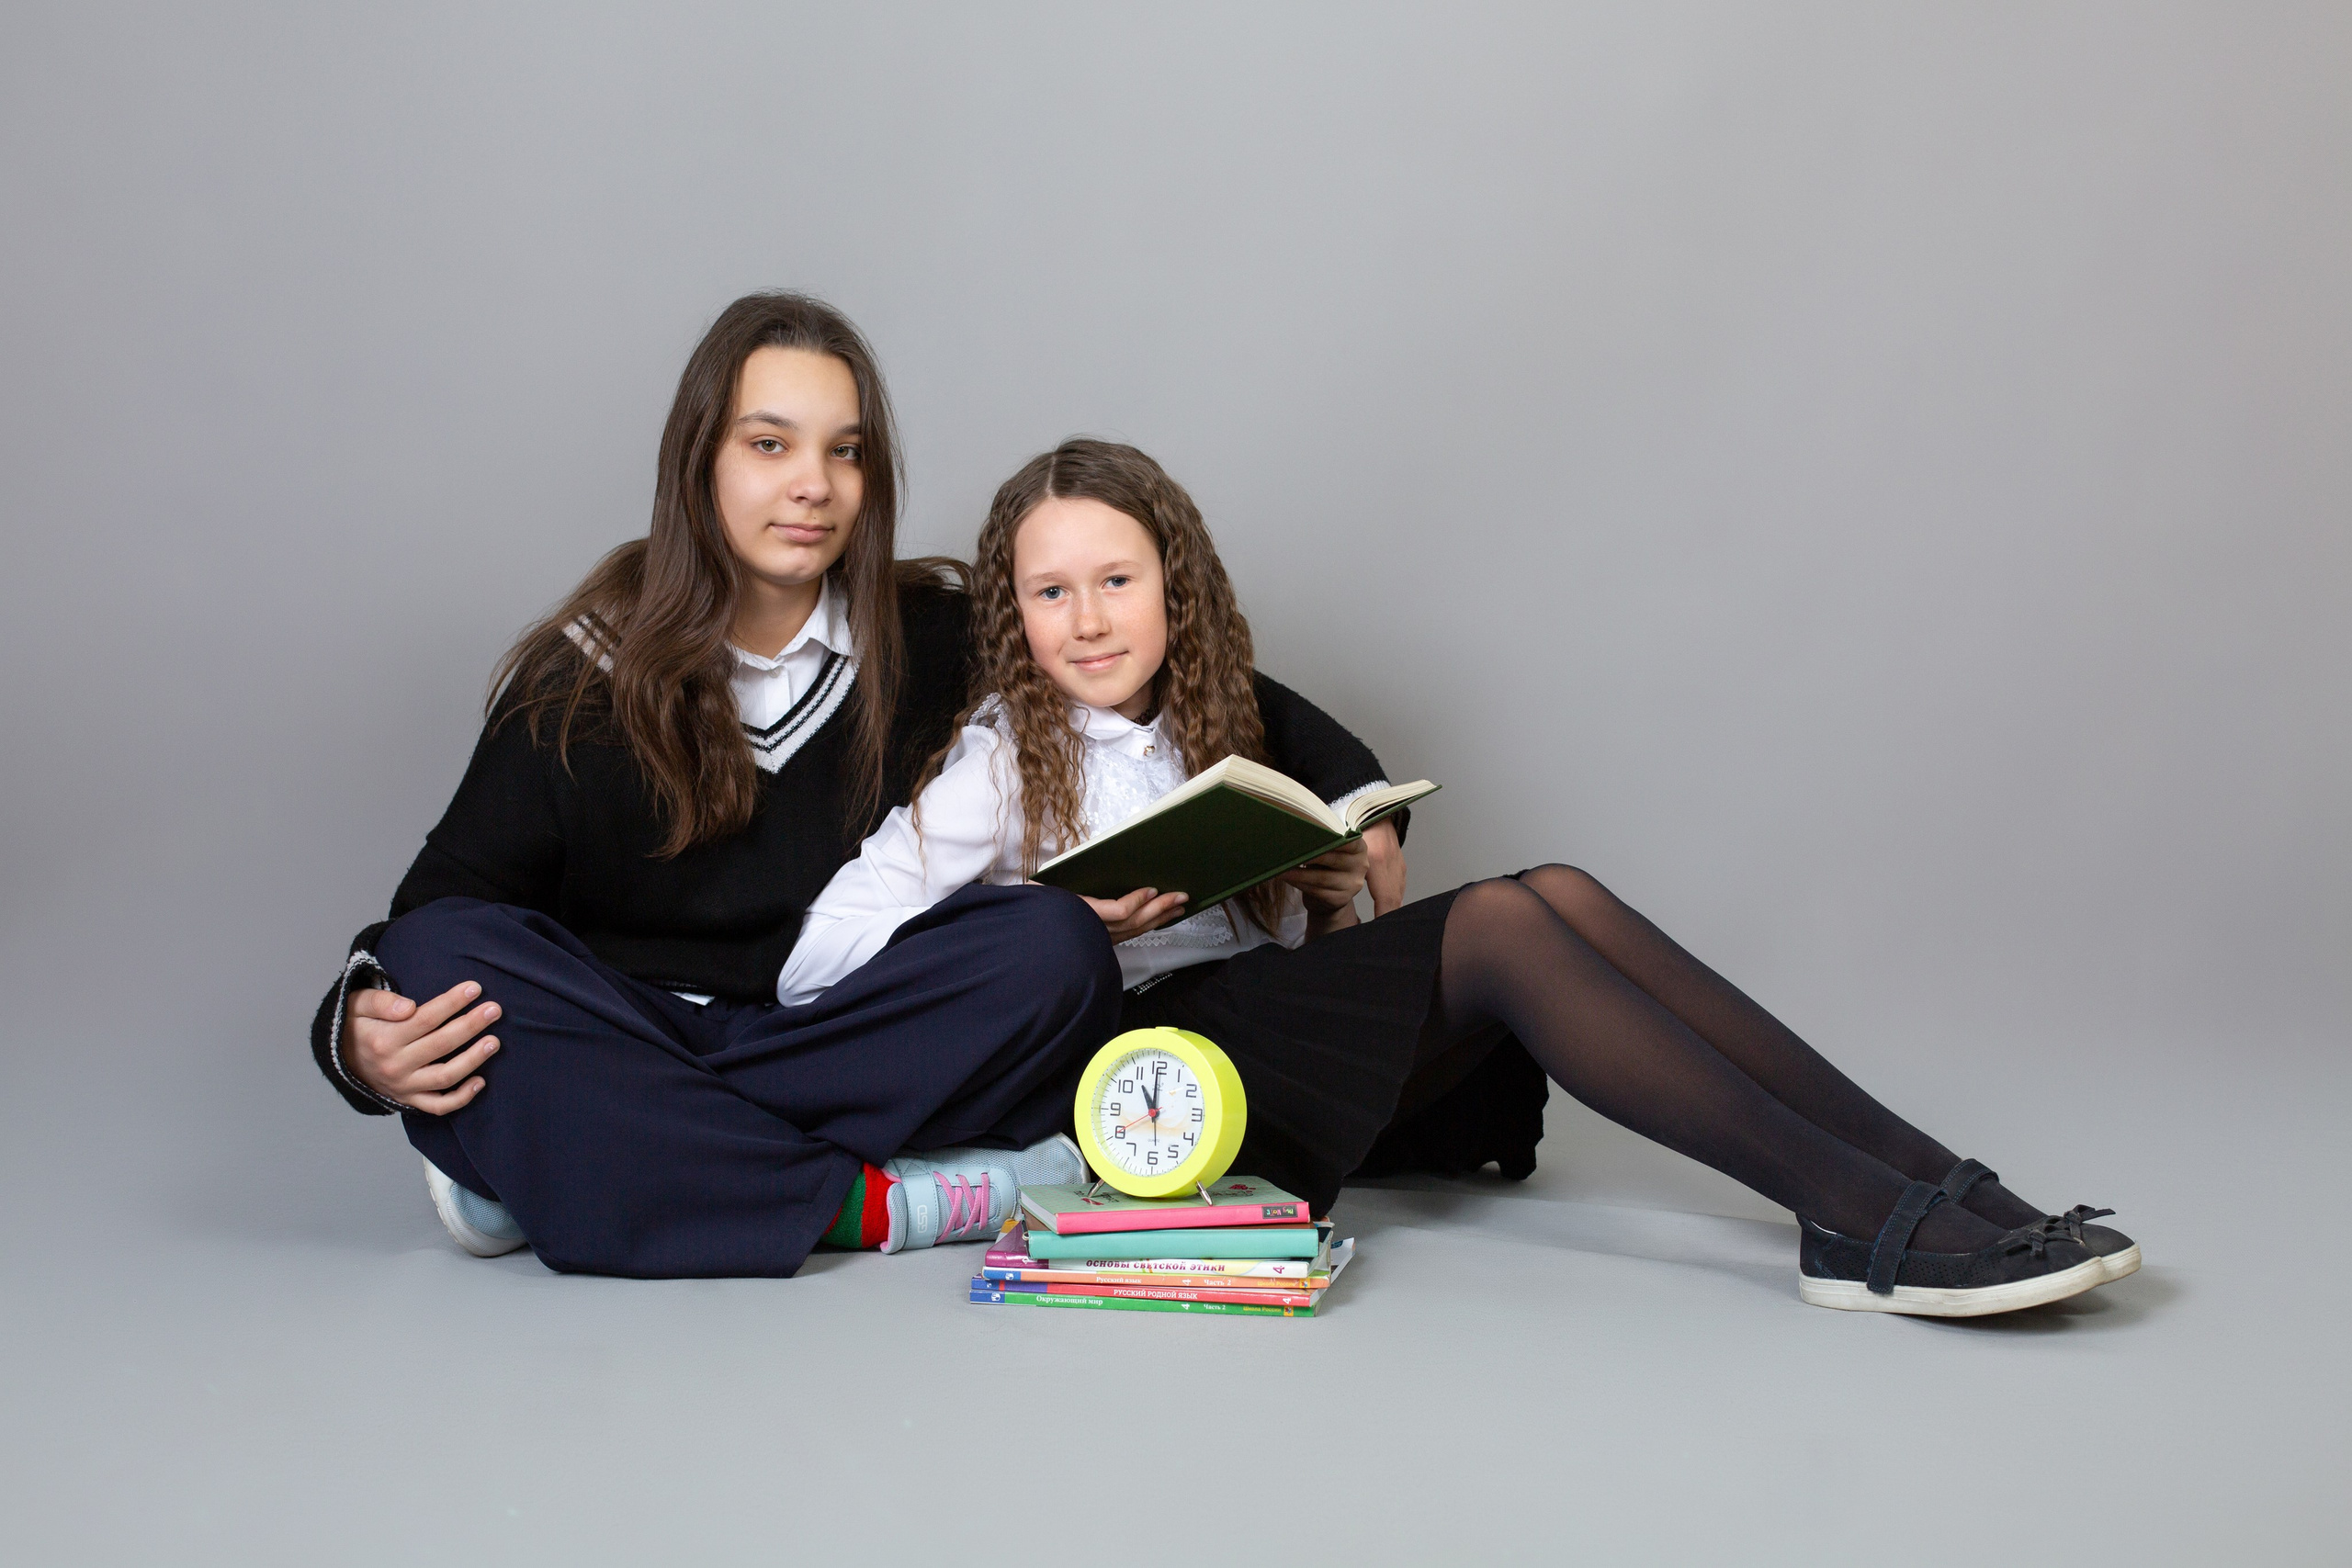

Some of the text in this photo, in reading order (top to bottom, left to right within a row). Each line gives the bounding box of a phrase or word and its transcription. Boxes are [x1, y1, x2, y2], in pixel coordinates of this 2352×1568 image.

[1136, 1066, 1144, 1080] 11
[1151, 1061, 1168, 1075] 12
[1177, 1068, 1181, 1083] 1
[1117, 1079, 1134, 1094] 10
[1185, 1084, 1197, 1098] 2
[1110, 1102, 1121, 1116] 9
[1191, 1108, 1203, 1122] 3
[1115, 1125, 1125, 1139] 8
[1183, 1132, 1194, 1146] 4
[1126, 1142, 1136, 1156] 7
[1168, 1145, 1179, 1158] 5
[1147, 1151, 1159, 1165] 6
[917, 1205, 927, 1233] GSD
[1086, 1259, 1226, 1271] ОСНОВЫ СВЕТСКОЙ ЭТИКИ
[1272, 1265, 1284, 1274] 4
[1036, 1295, 1087, 1305] Окружающий
[1114, 1288, 1198, 1300] РУССКИЙ РОДНОЙ ЯЗЫК
